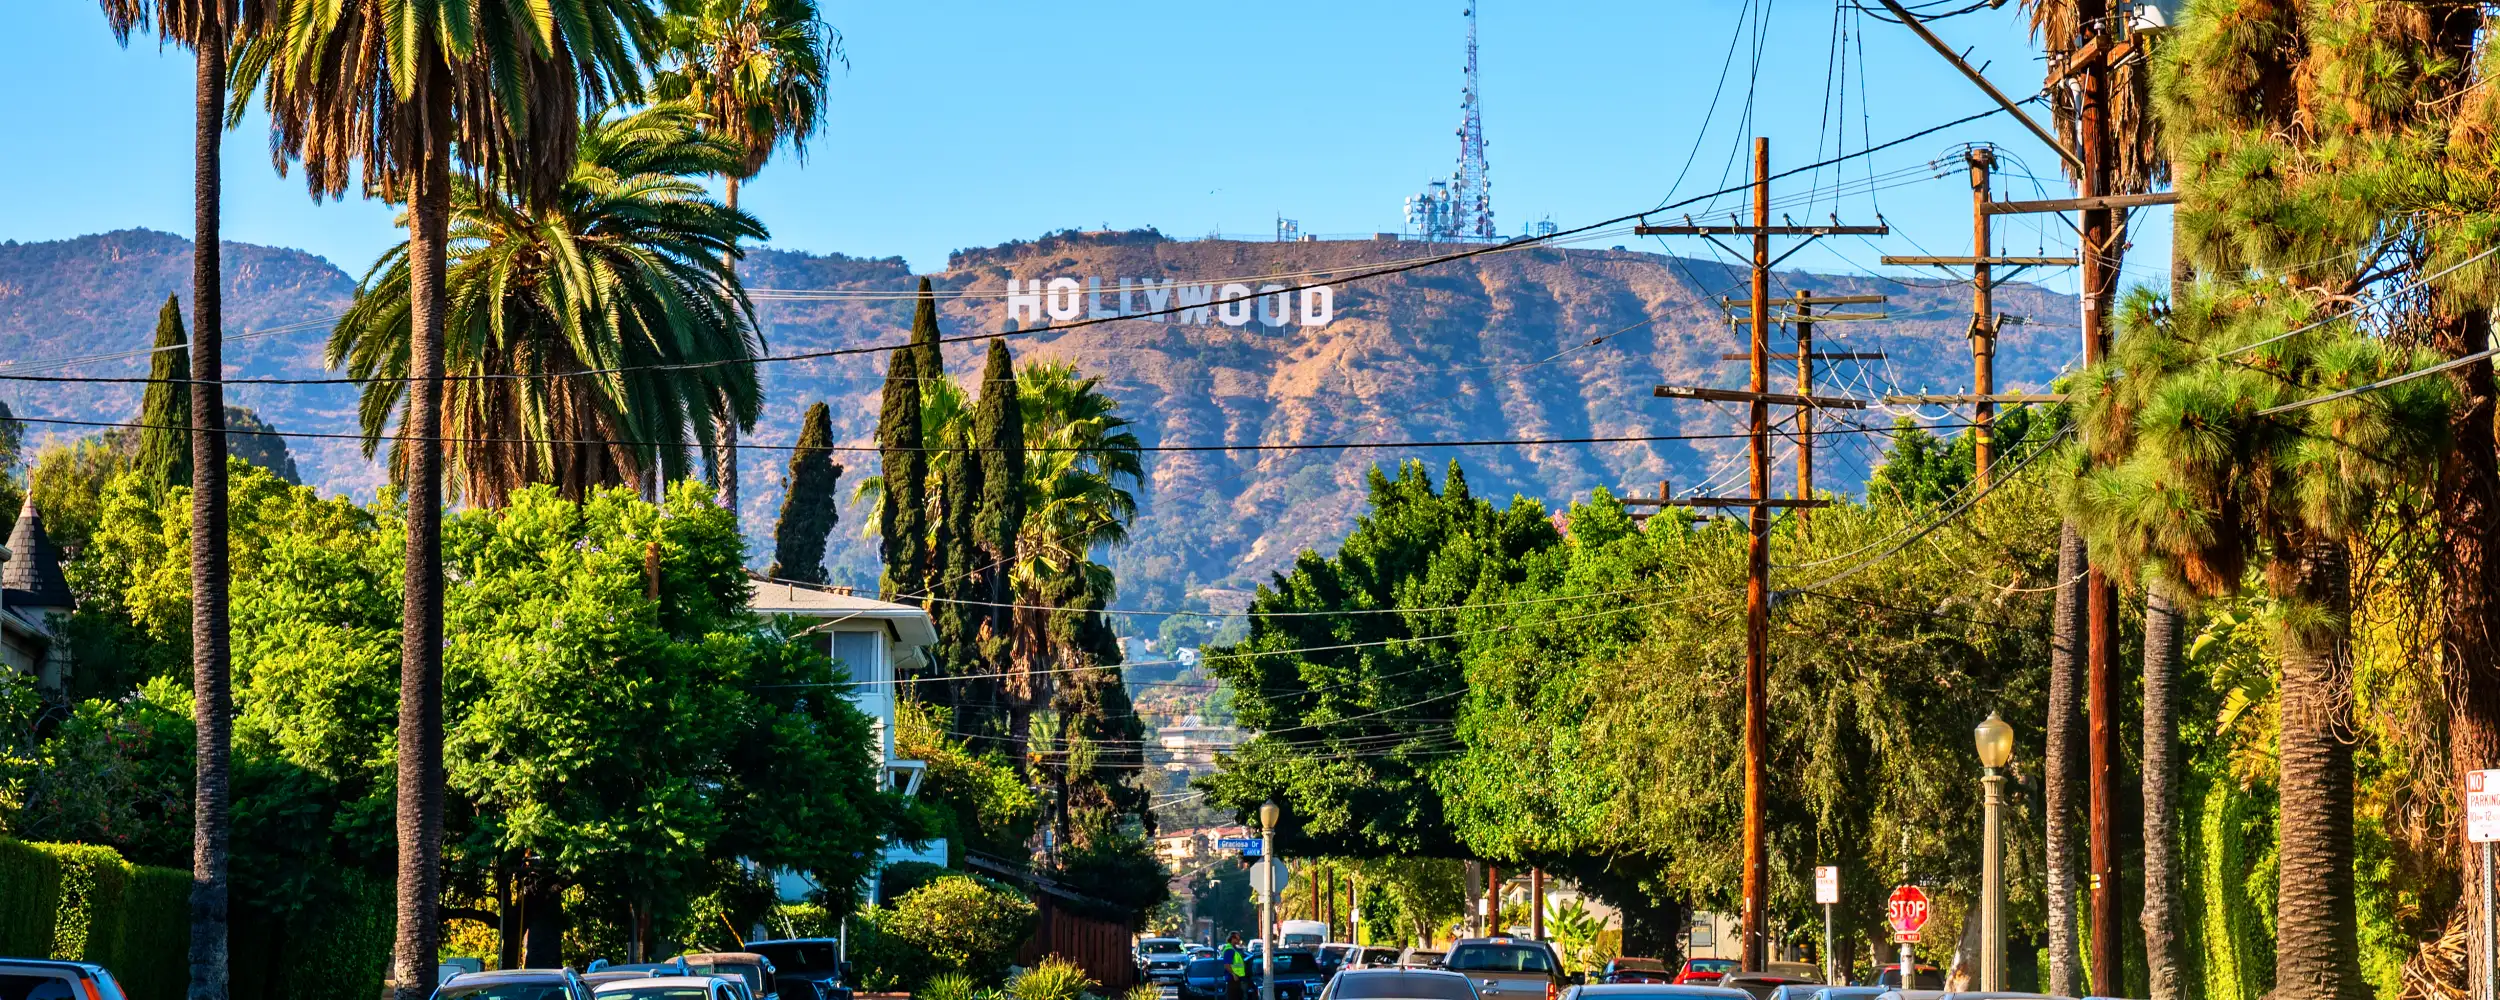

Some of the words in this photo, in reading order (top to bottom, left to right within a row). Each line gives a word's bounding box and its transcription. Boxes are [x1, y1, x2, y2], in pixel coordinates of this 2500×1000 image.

[1007, 276, 1333, 327] HOLLYWOOD
[2470, 775, 2482, 790] NO
[2471, 794, 2500, 807] PARKING
[1891, 901, 1926, 918] STOP
